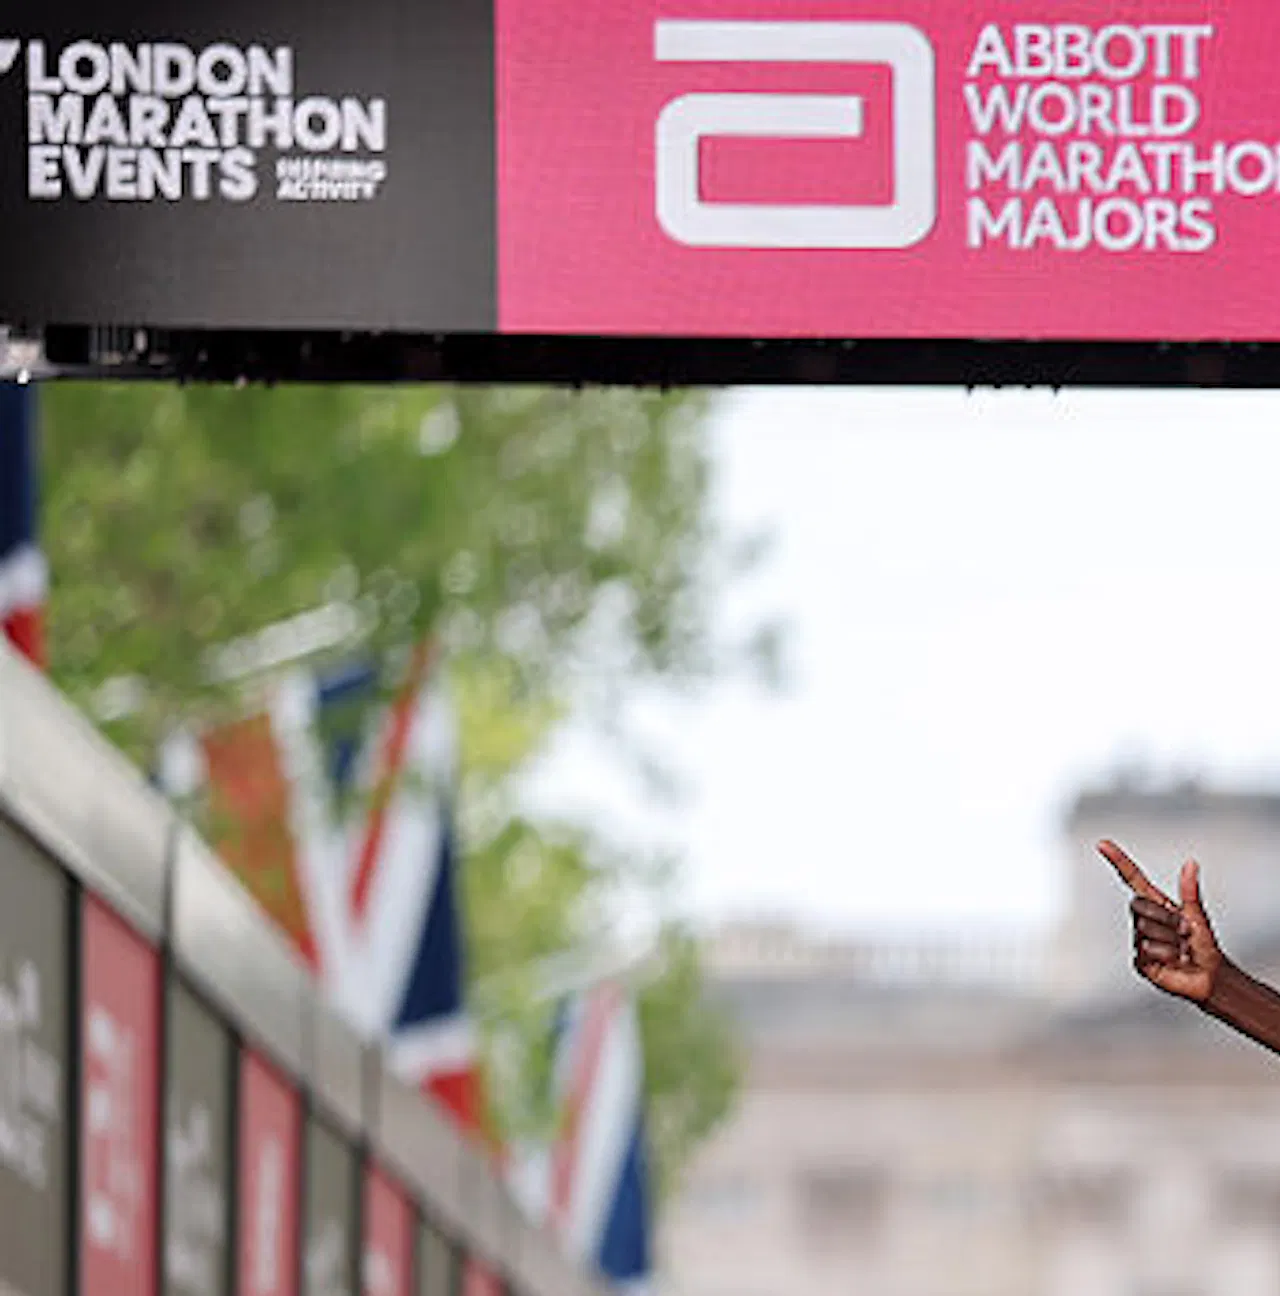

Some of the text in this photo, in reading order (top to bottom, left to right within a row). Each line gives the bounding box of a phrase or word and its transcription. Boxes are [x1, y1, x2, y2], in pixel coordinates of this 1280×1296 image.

[27, 40, 292, 96] LONDON
[966, 25, 1212, 78] ABBOTT
[27, 93, 386, 151] MARATHON
[966, 85, 1199, 136] WORLD
[27, 147, 258, 199] EVENTS
[966, 198, 1217, 250] MAJORS
